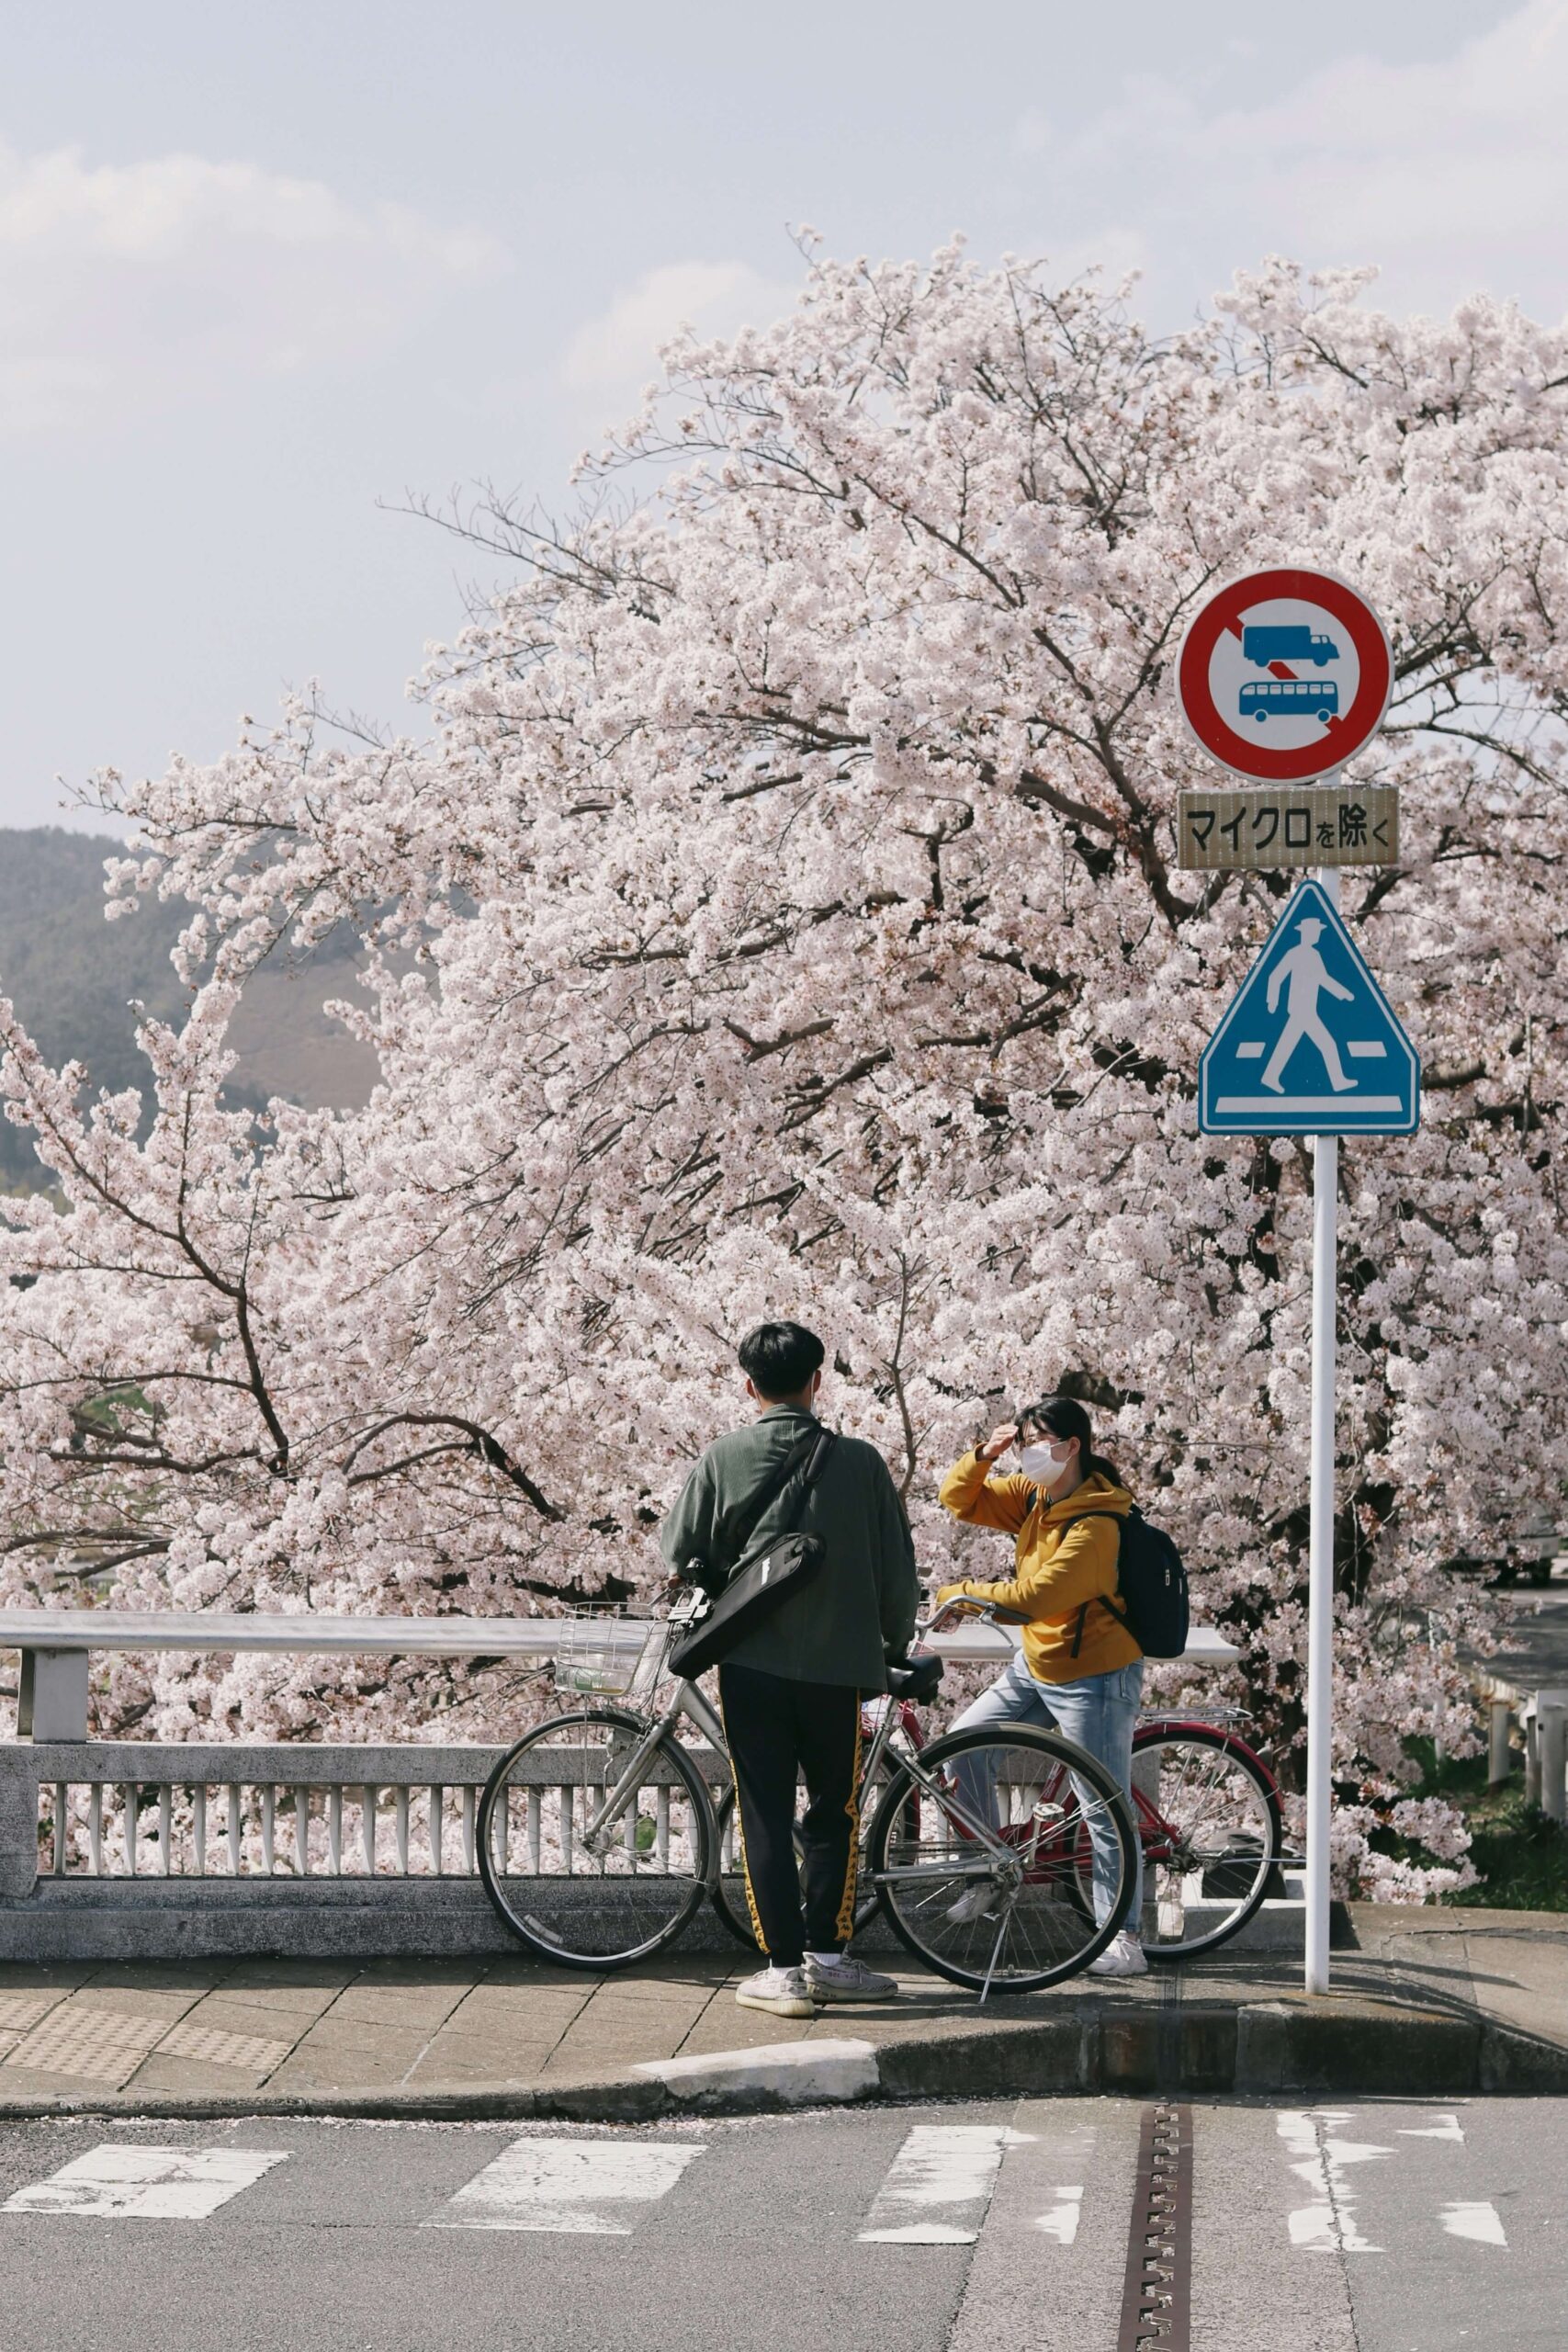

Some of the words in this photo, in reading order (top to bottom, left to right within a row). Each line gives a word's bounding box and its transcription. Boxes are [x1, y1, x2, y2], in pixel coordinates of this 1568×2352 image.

[1187, 802, 1389, 852] マイクロを除く
